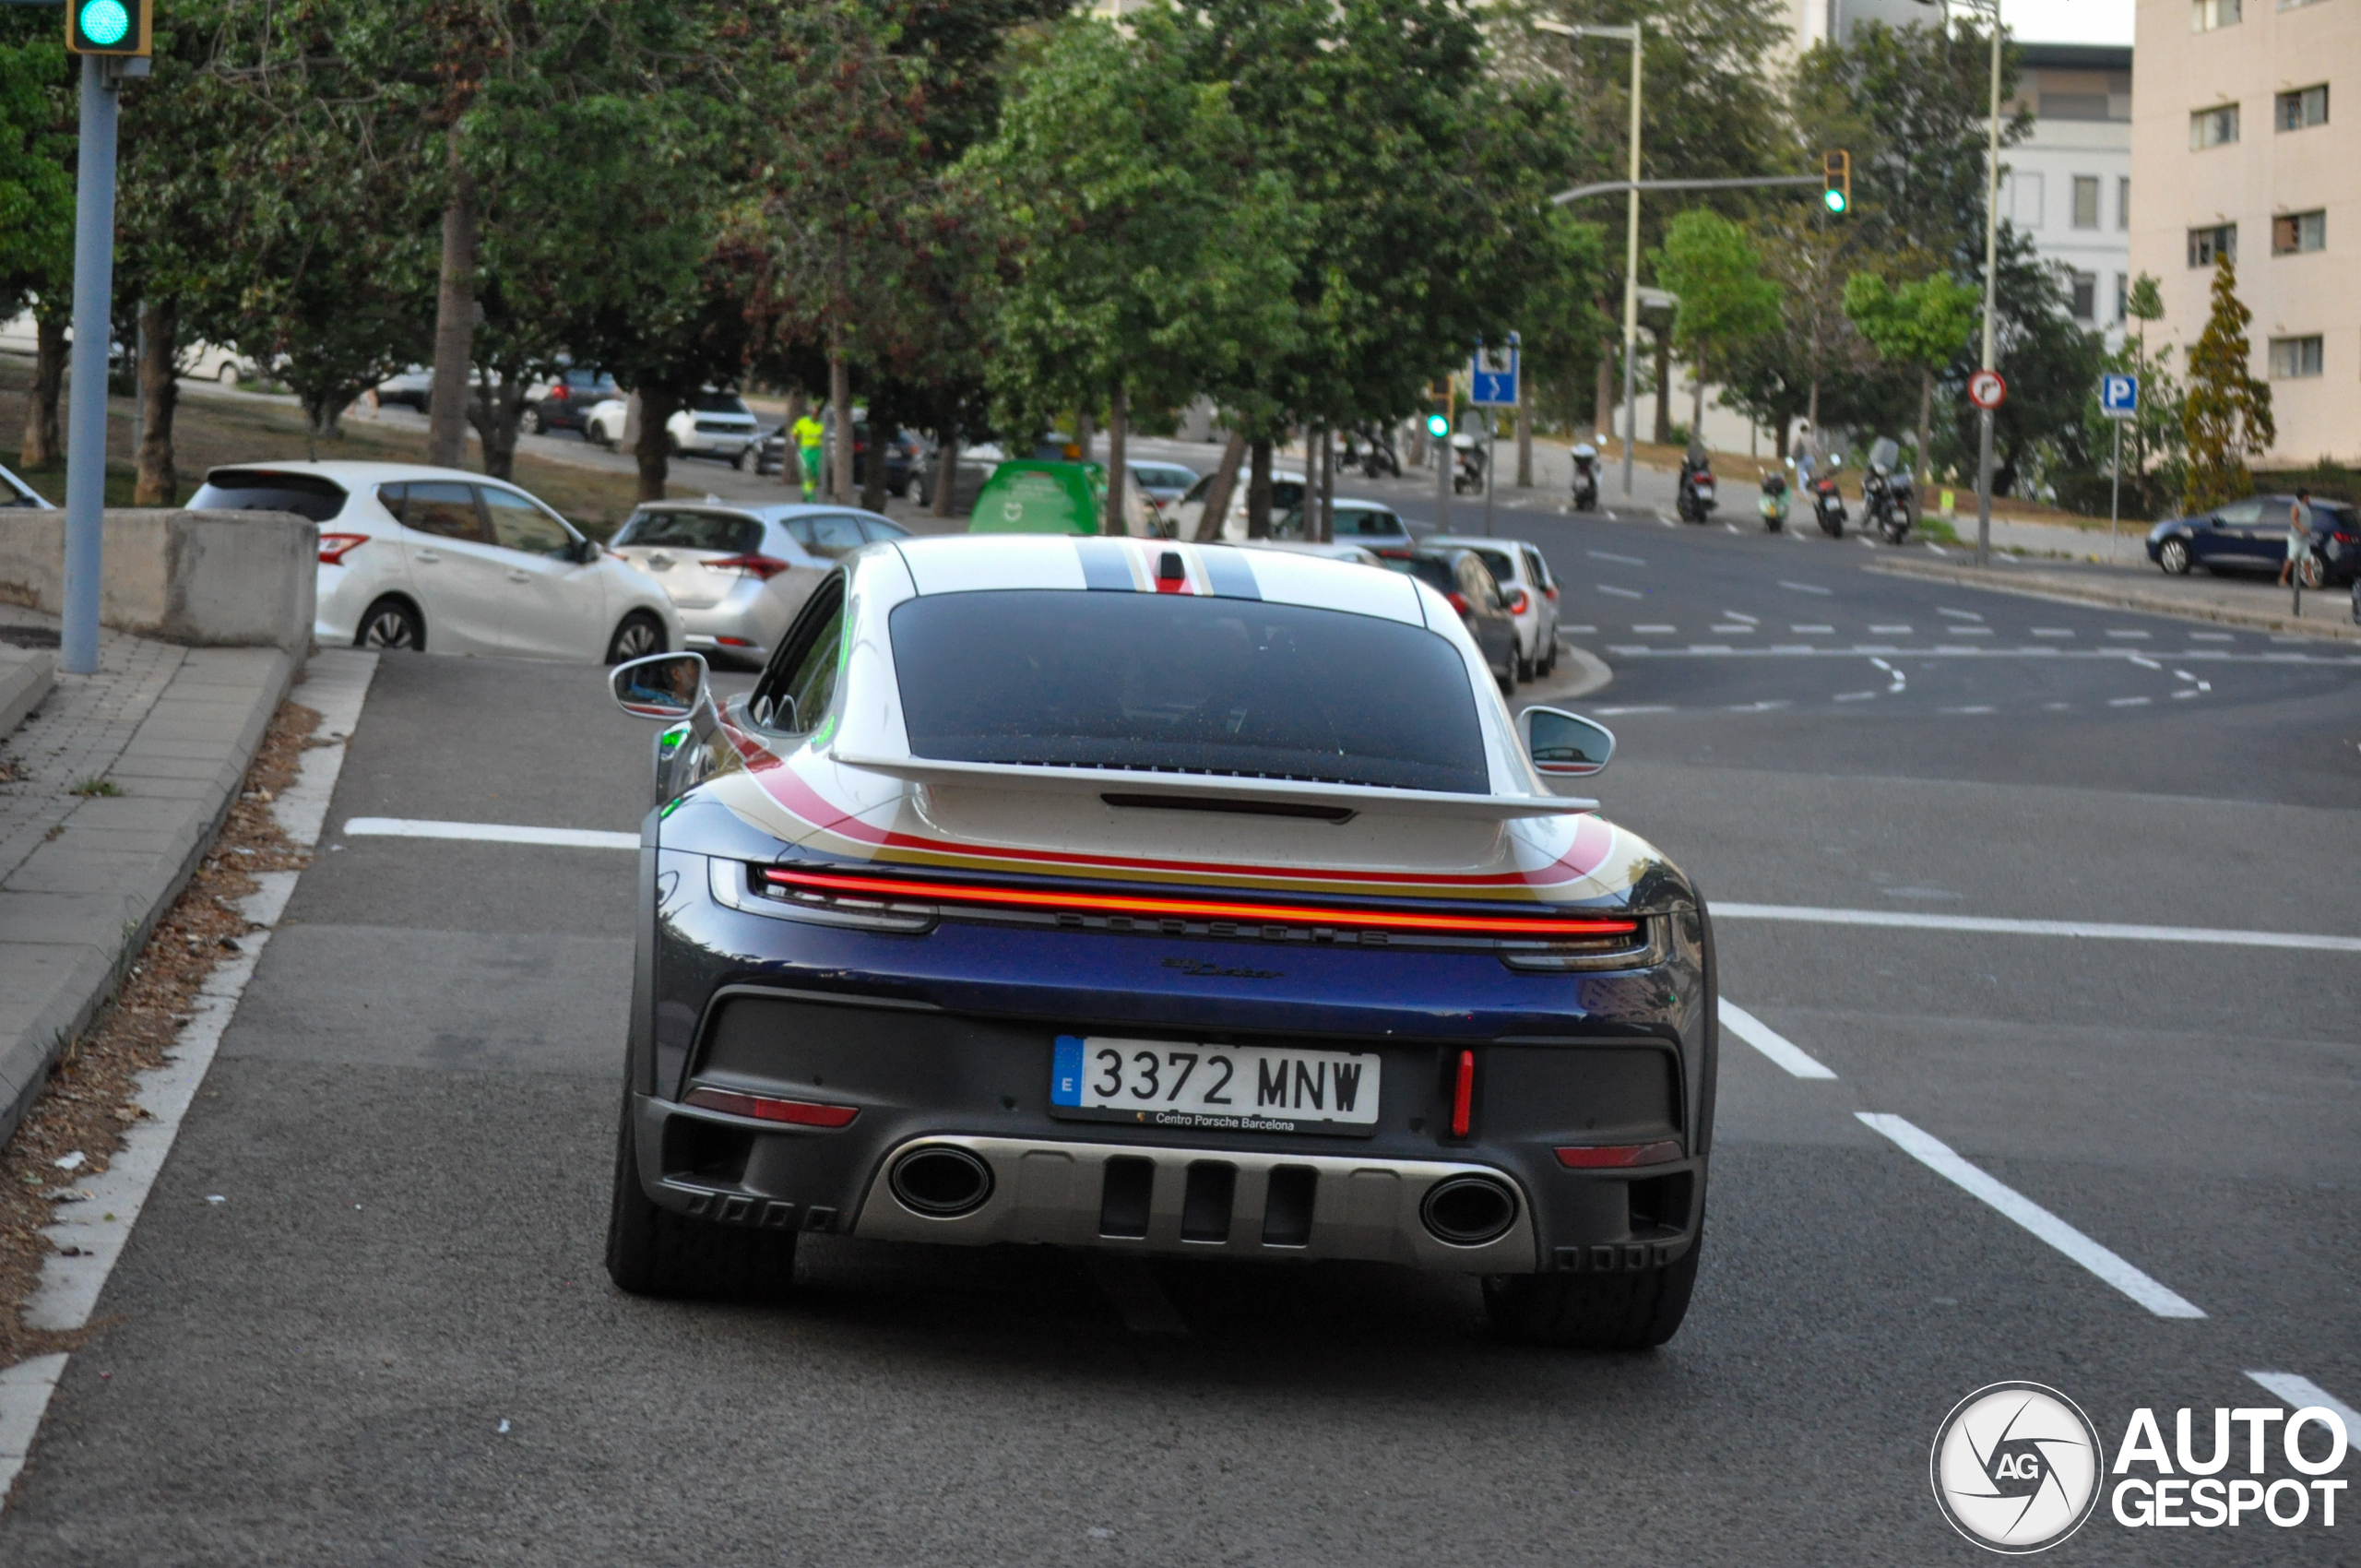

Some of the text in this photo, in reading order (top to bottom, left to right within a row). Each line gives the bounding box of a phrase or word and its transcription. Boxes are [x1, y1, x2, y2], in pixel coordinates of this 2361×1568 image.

[2108, 379, 2131, 407] P
[1062, 1077, 1074, 1092] E
[1093, 1048, 1362, 1112] 3372 MNW
[1156, 1112, 1295, 1132] Centro Porsche Barcelona
